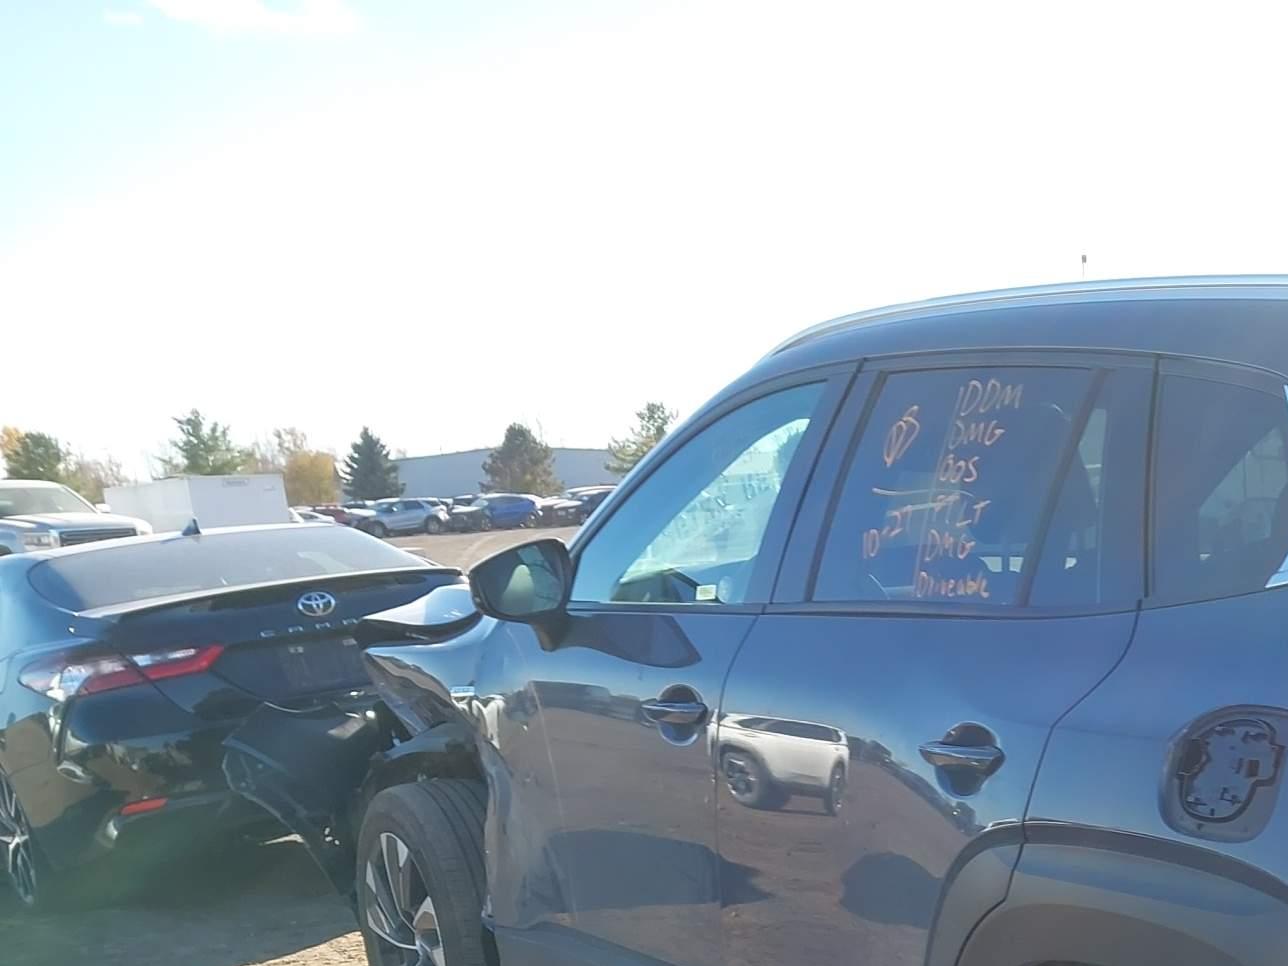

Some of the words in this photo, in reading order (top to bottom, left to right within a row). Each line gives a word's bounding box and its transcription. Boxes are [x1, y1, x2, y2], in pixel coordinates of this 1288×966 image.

[946, 419, 1005, 450] DMG
[922, 528, 977, 562] DMG
[259, 617, 360, 638] CAMR
